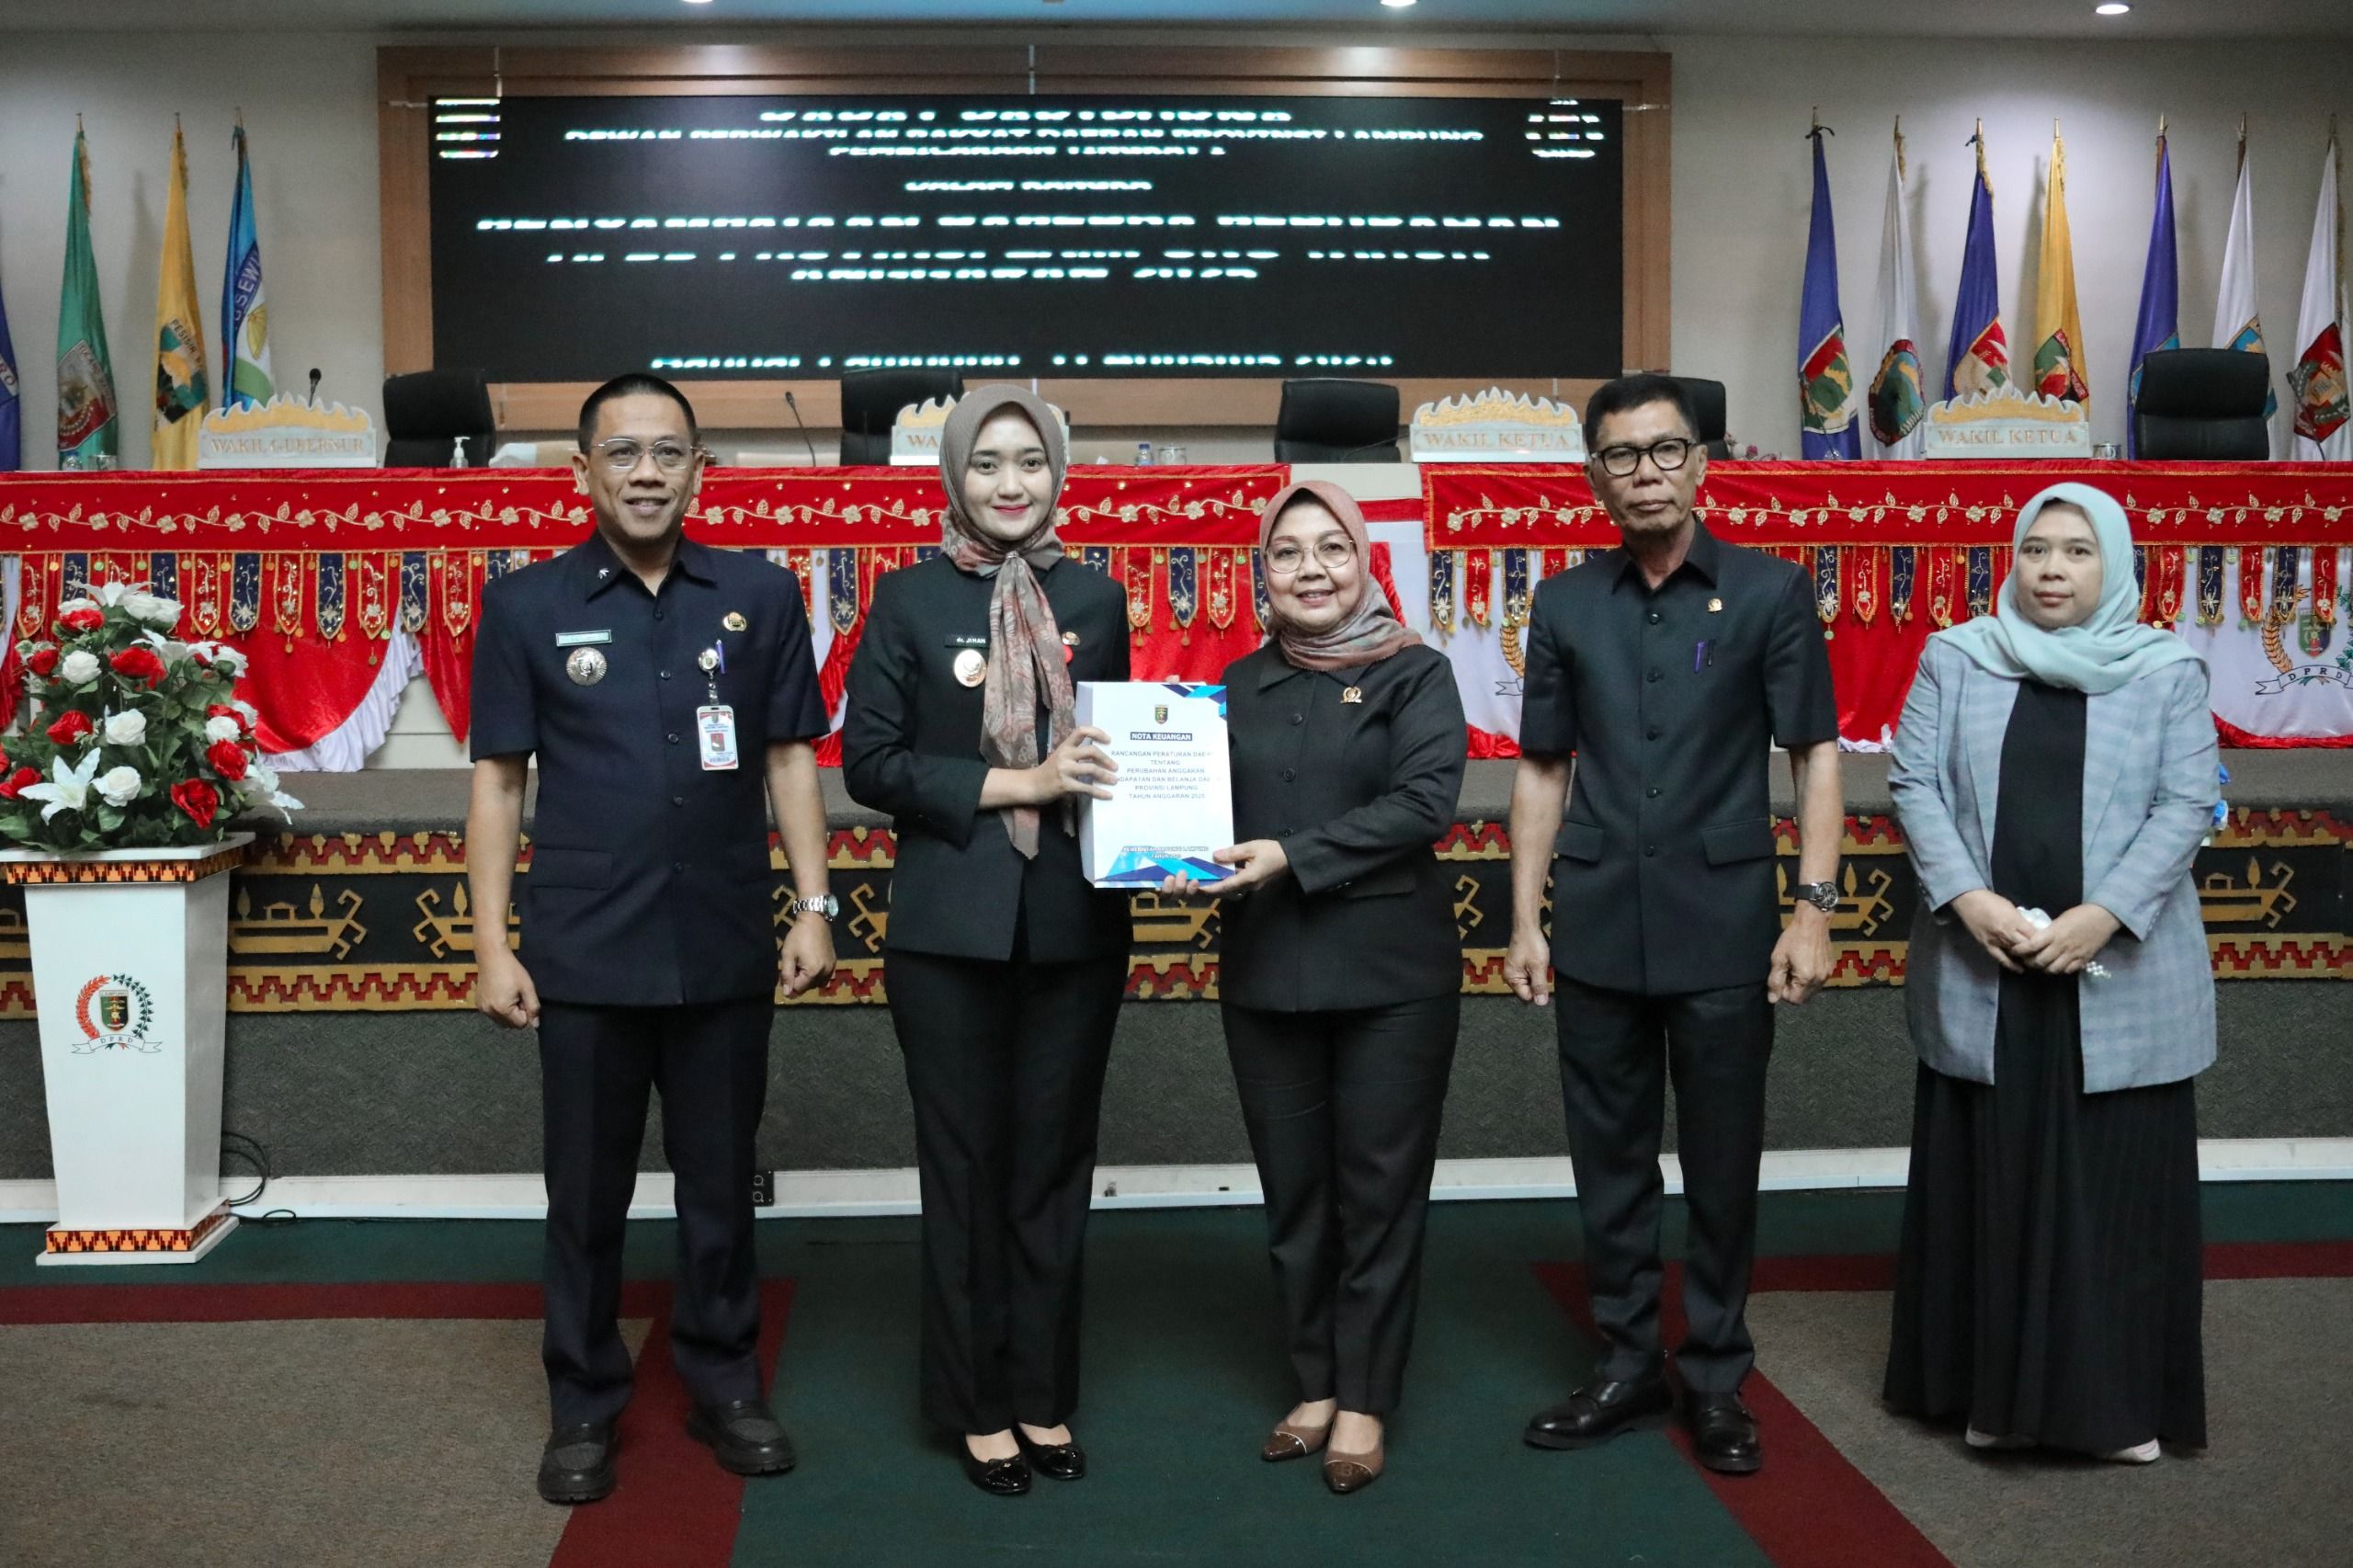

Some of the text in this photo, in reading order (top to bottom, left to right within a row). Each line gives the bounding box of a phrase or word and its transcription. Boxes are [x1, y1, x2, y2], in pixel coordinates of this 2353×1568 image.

[907, 434, 939, 449] WA
[1424, 433, 1571, 449] WAKIL KETUA
[1938, 429, 2077, 444] WAKIL KETUA
[211, 437, 364, 453] WAKIL GUBERNUR
[2288, 667, 2343, 681] DPRD
[1131, 733, 1192, 742] NOTA KEUANGAN
